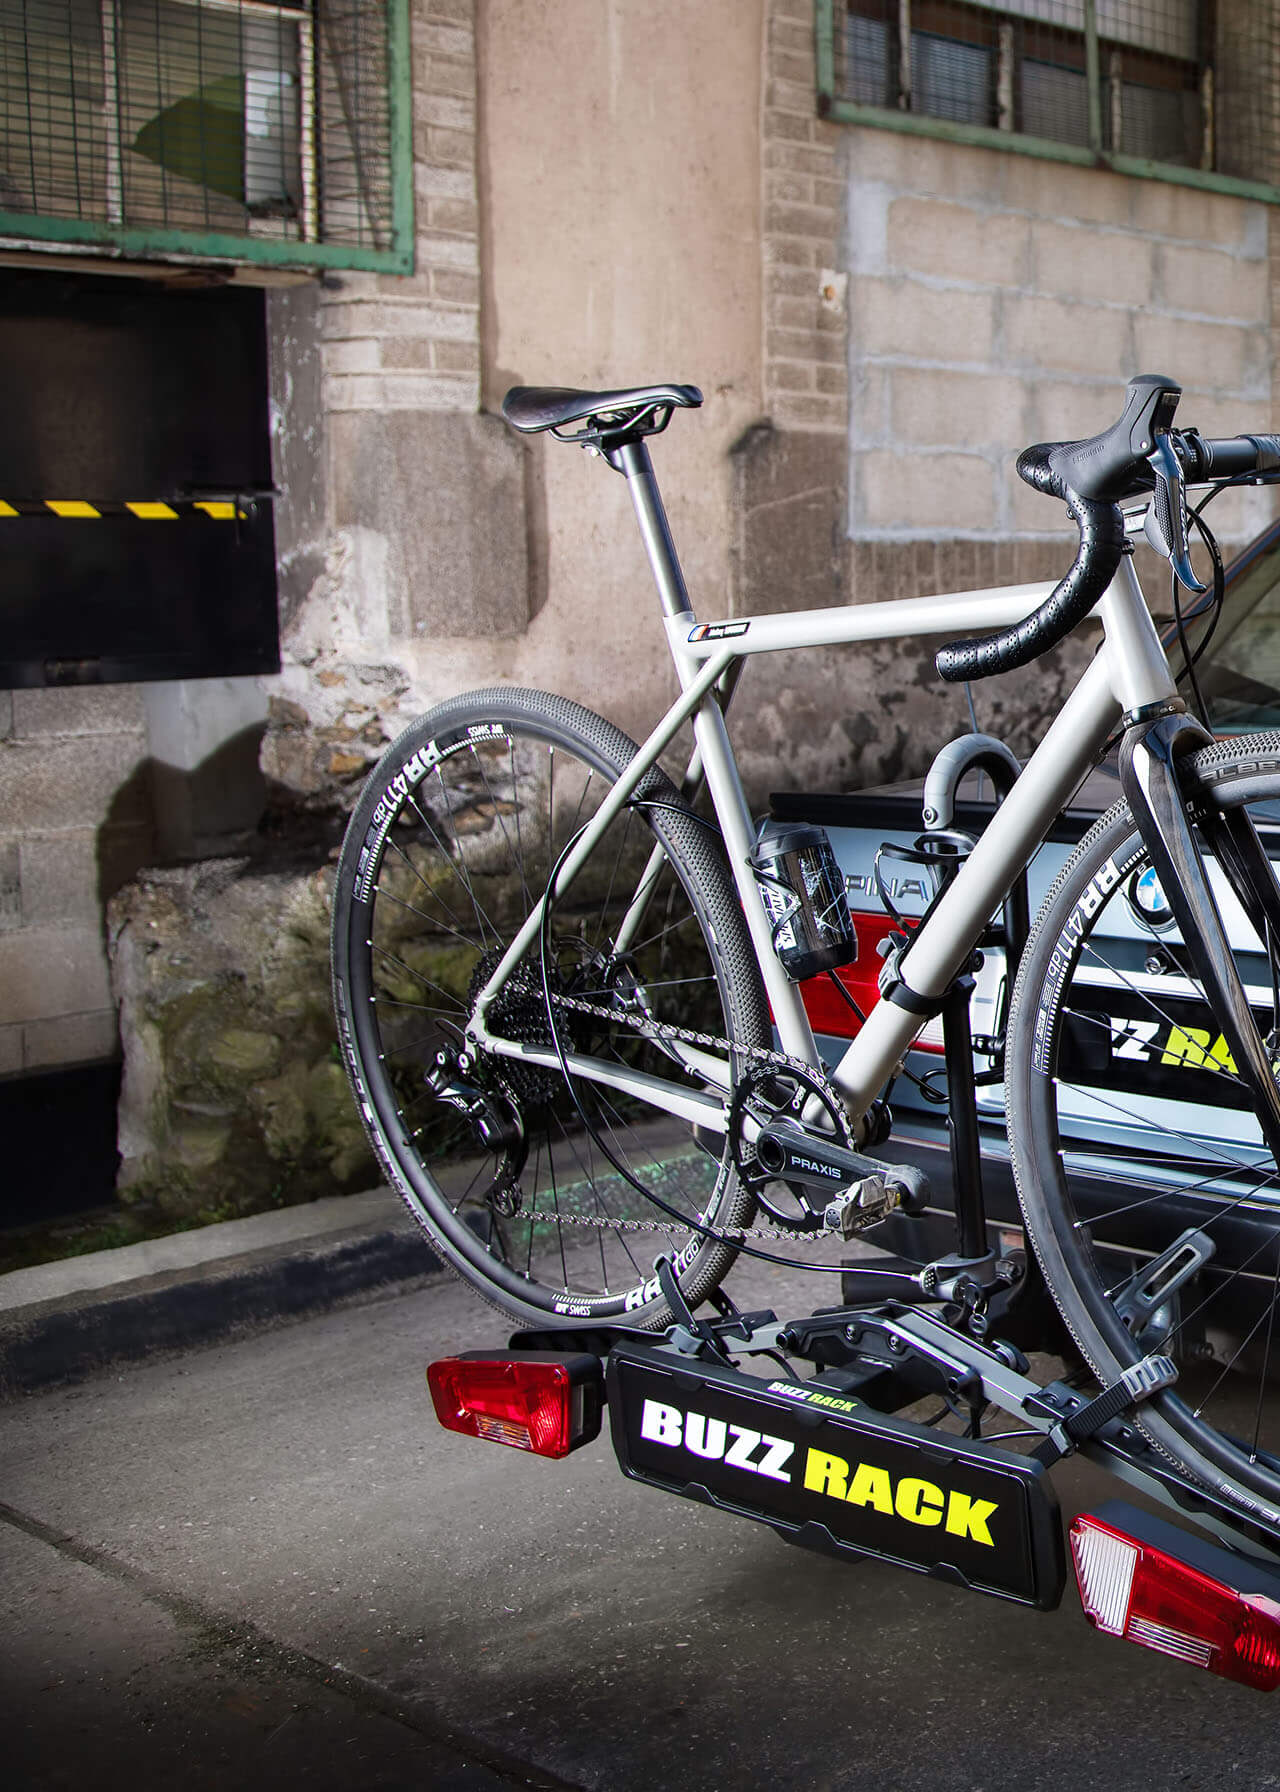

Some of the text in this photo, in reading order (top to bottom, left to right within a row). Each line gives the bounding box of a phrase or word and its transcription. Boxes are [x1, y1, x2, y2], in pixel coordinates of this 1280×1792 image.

[844, 874, 929, 902] PINA
[791, 1155, 842, 1179] PRAXIS
[767, 1381, 858, 1412] BUZZ RACK
[640, 1398, 999, 1547] BUZZ RACK
